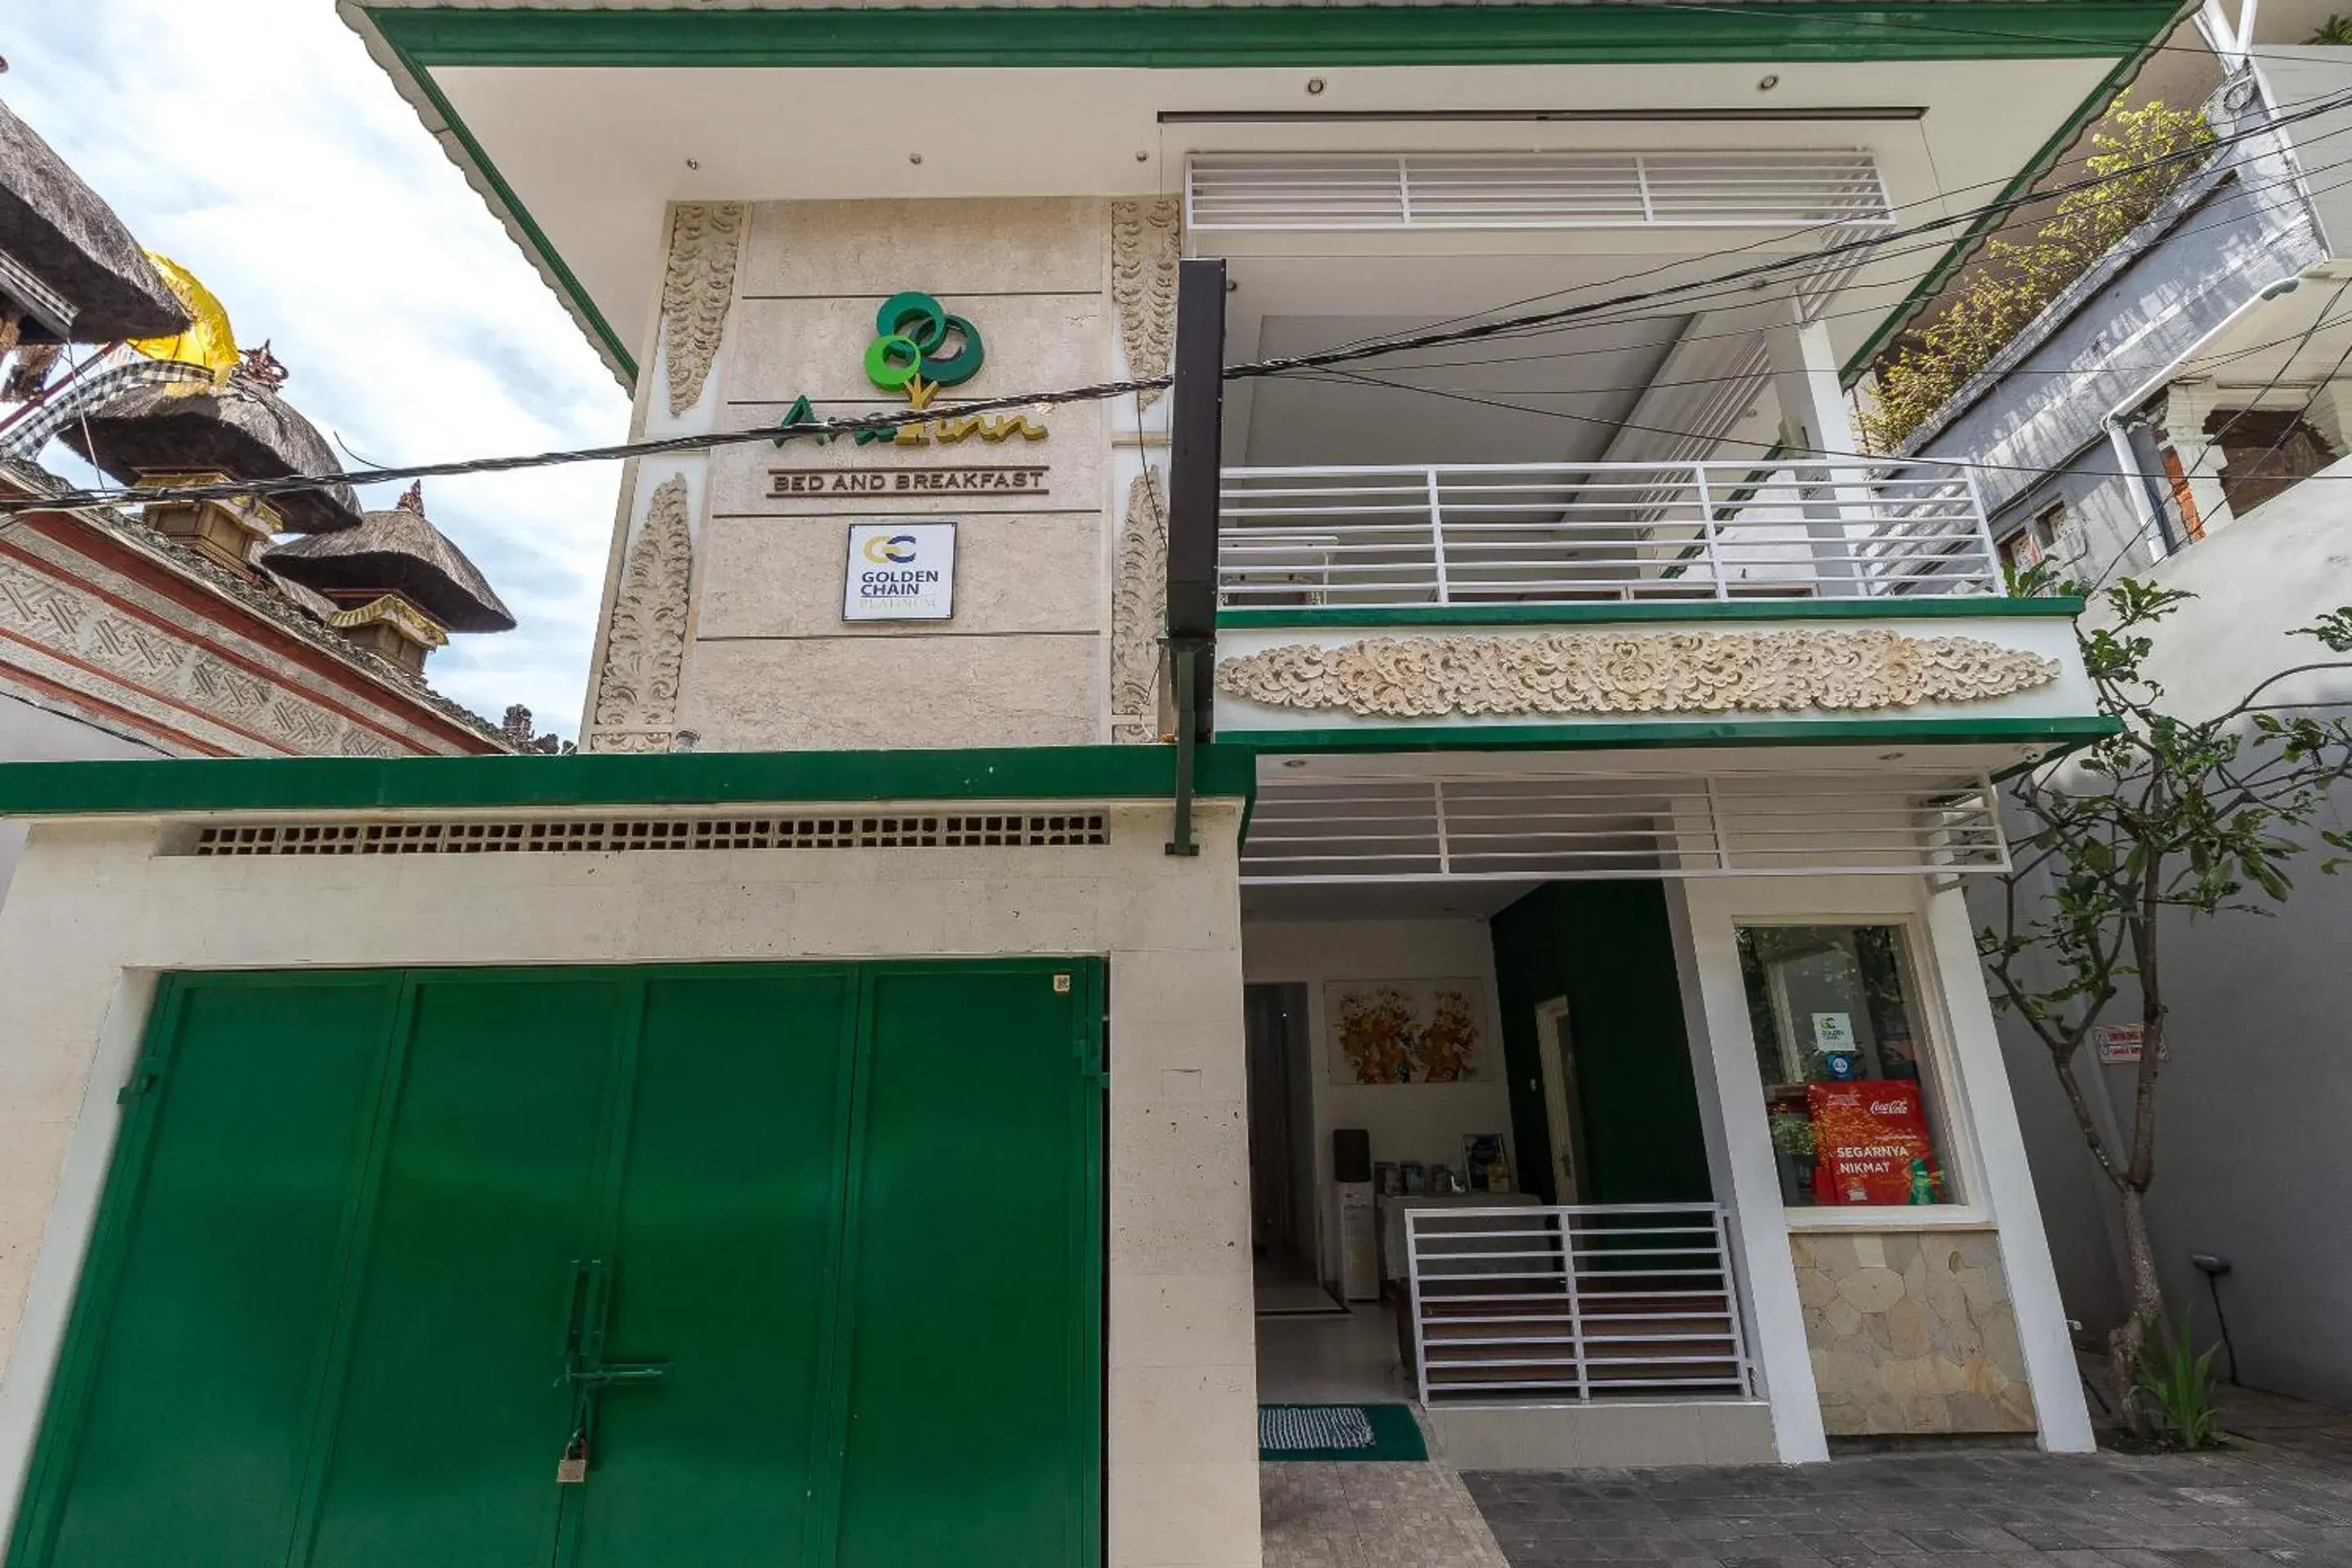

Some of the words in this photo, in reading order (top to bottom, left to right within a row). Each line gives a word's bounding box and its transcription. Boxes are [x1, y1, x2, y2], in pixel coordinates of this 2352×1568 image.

[774, 476, 824, 491] BED
[832, 475, 885, 490] AND
[895, 472, 1043, 489] BREAKFAST
[862, 571, 938, 582] GOLDEN
[861, 584, 920, 595] CHAIN
[1837, 1146, 1909, 1158] SEGARNYA
[1840, 1162, 1890, 1174] NIKMAT
